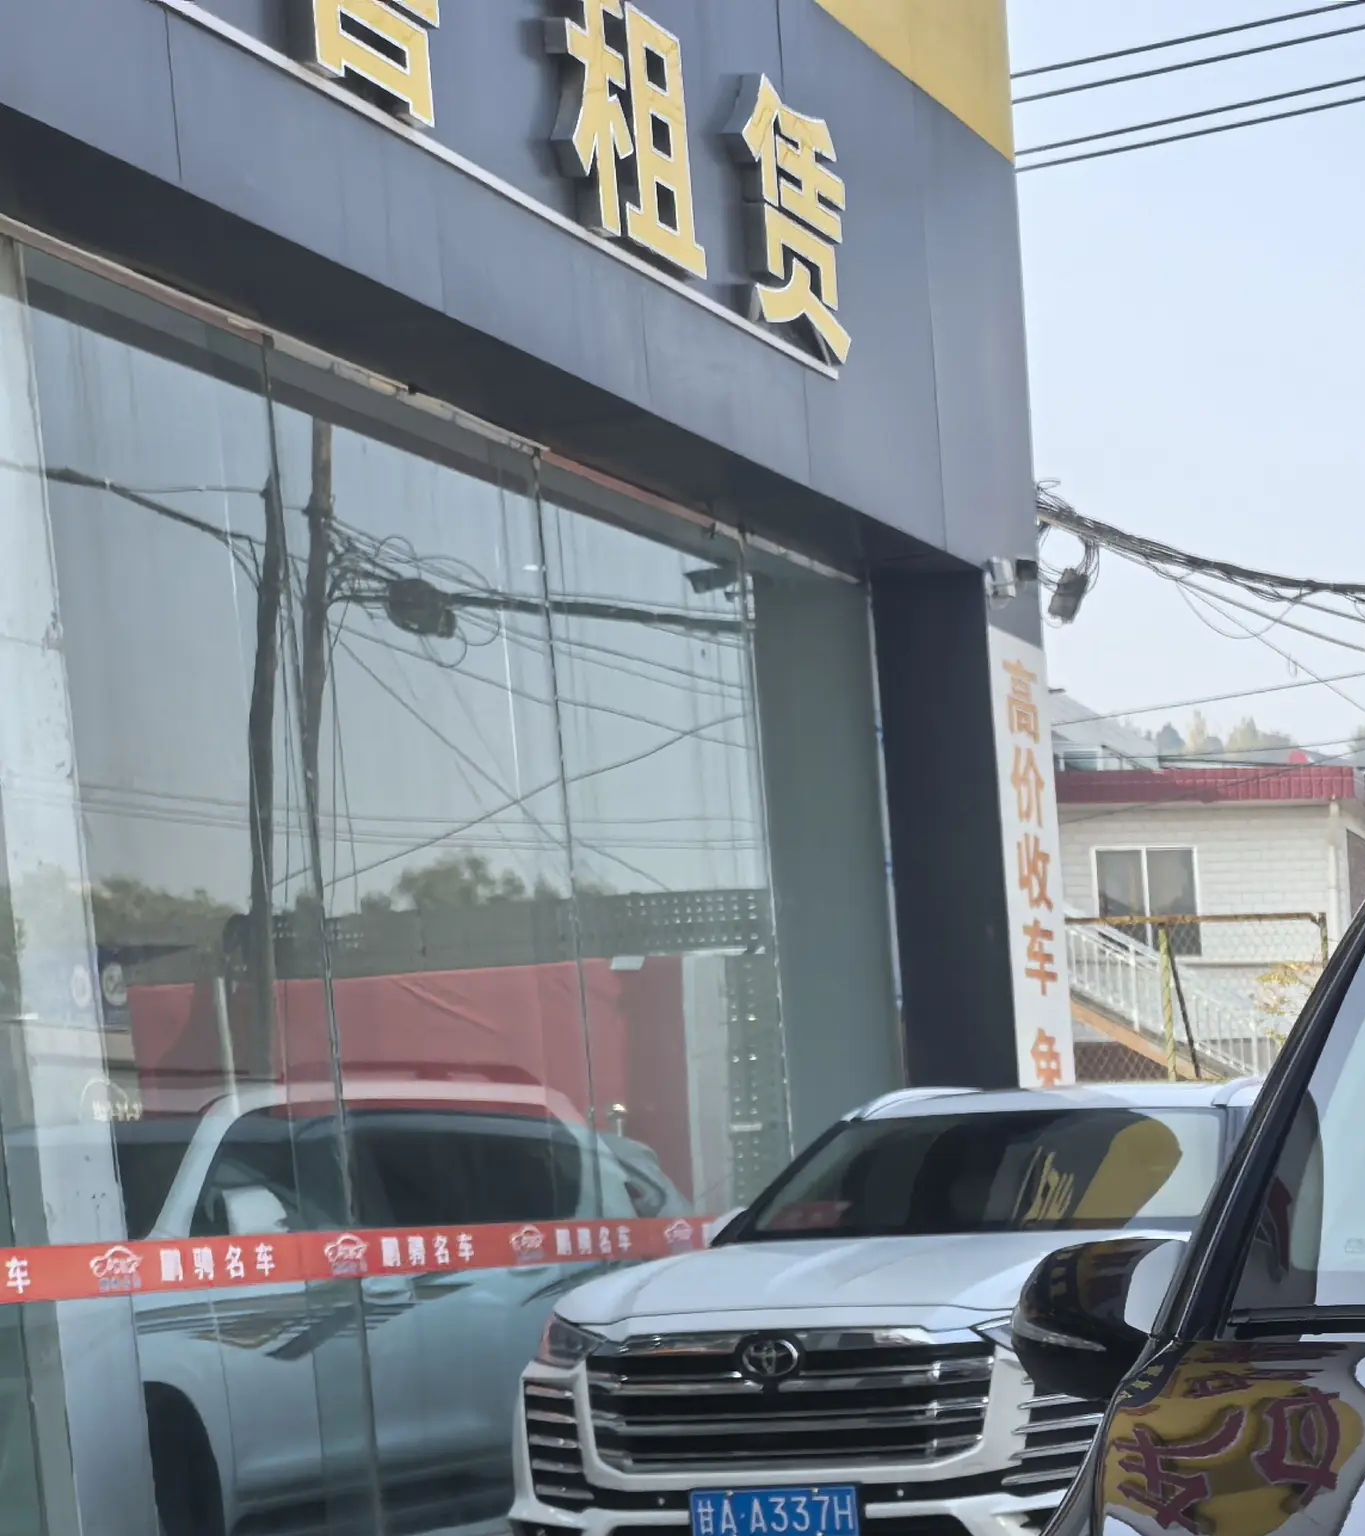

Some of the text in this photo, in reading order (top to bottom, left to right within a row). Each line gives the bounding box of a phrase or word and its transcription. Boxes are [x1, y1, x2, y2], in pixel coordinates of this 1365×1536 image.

[1001, 658, 1059, 997] 高价收车
[6, 1256, 30, 1294] 车
